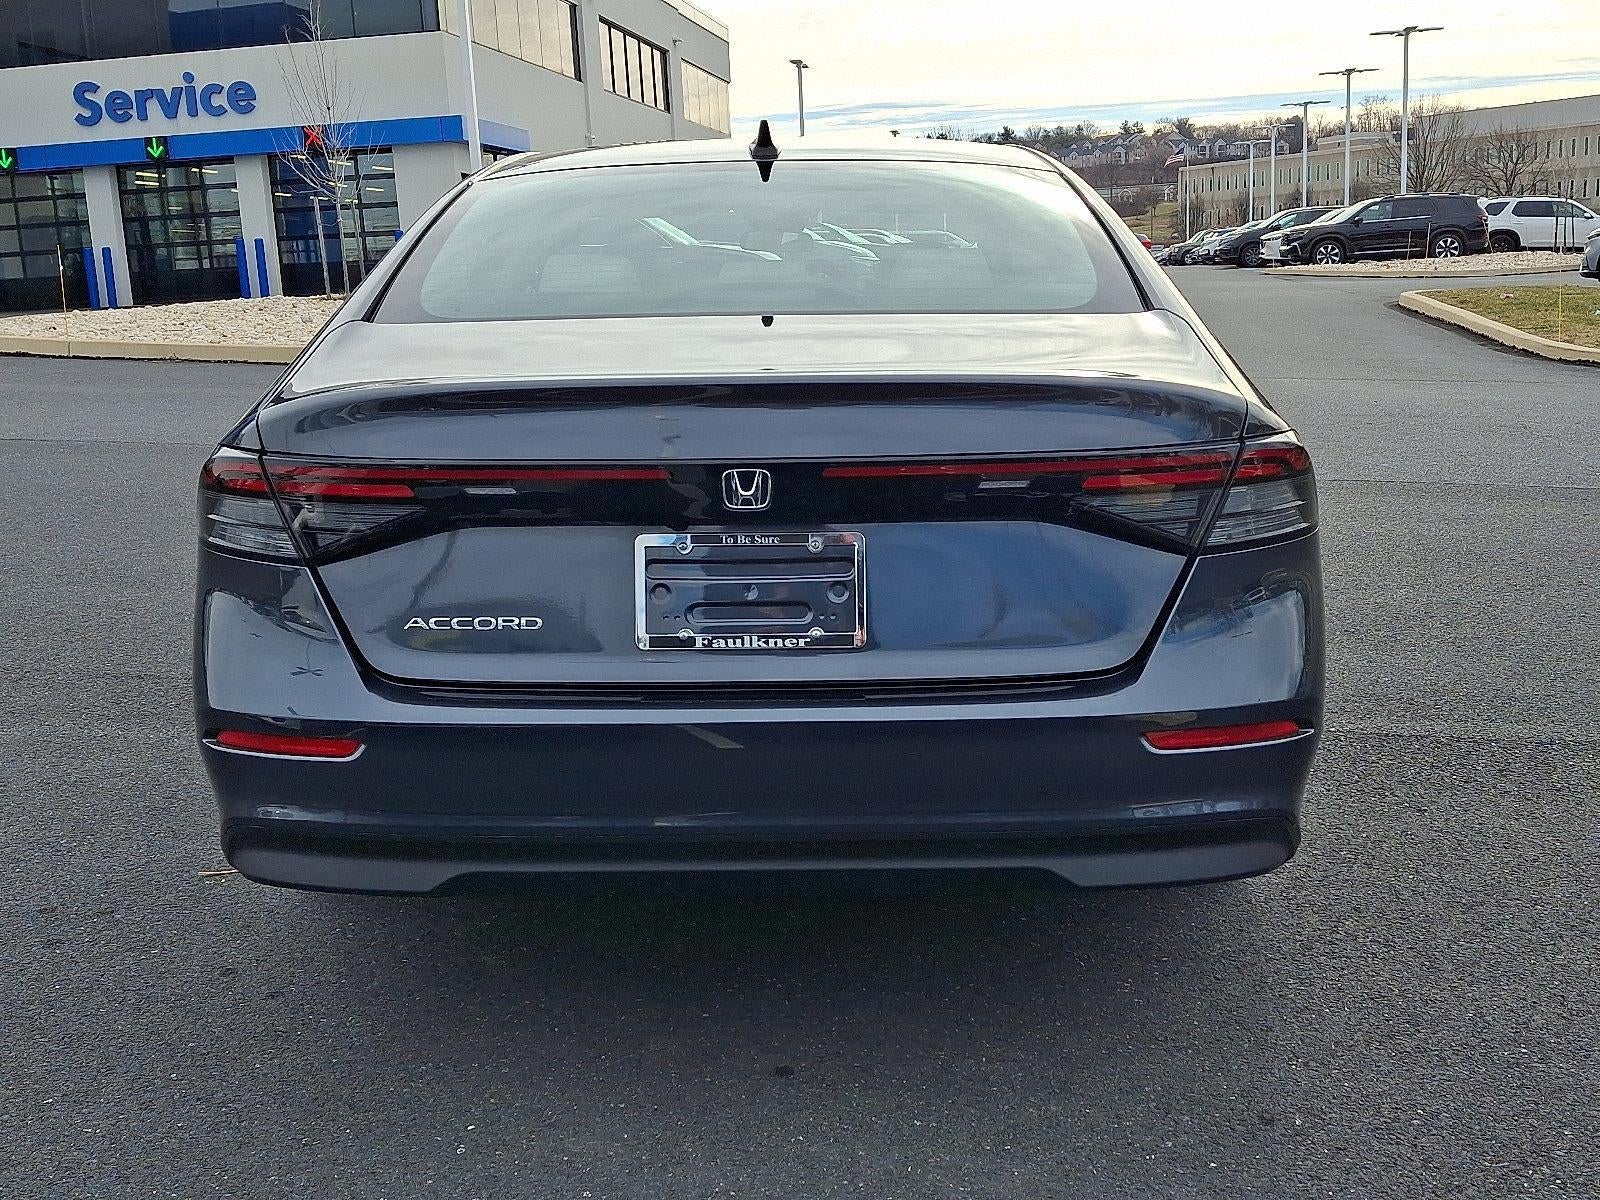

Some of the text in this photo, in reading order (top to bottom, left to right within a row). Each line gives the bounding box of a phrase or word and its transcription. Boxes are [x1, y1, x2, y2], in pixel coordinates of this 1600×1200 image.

[72, 71, 257, 127] Service
[720, 534, 781, 544] To Be Sure
[403, 616, 543, 631] ACCORD
[693, 635, 811, 648] Faulkner
